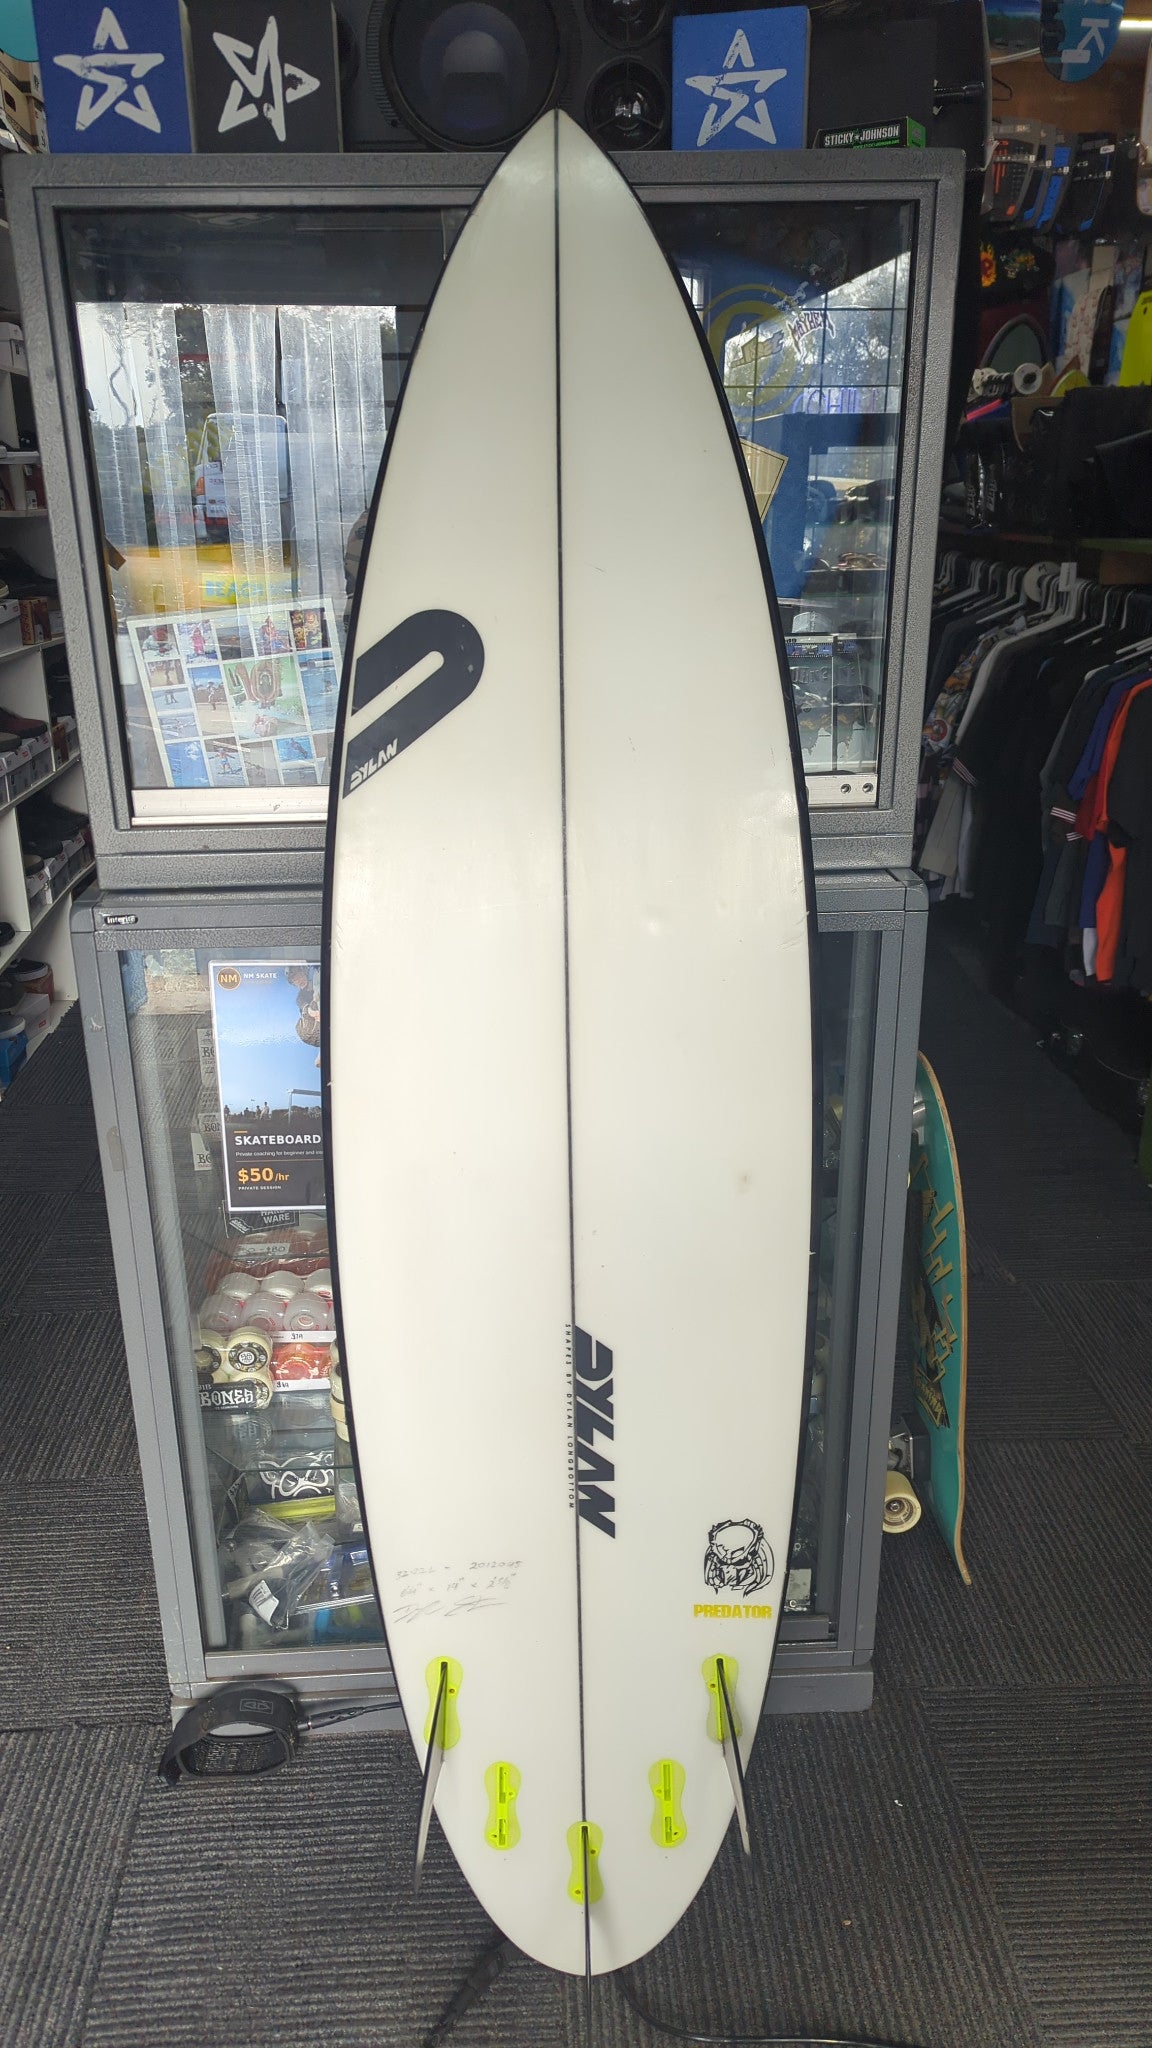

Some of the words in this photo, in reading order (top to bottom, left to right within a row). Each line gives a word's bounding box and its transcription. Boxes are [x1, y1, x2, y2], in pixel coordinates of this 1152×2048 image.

[824, 132, 854, 146] STICKY
[860, 124, 900, 141] JOHNSON
[349, 737, 398, 791] DYLAN
[220, 974, 238, 983] NM
[234, 1134, 322, 1146] SKATEBOARD
[238, 1167, 274, 1184] $50
[263, 1213, 291, 1224] WARE
[565, 1373, 573, 1386] BY
[199, 1388, 254, 1407] BONES
[566, 1393, 574, 1428] DYLAN
[574, 1325, 616, 1539] DYLAN
[693, 1604, 773, 1619] PREDATOR
